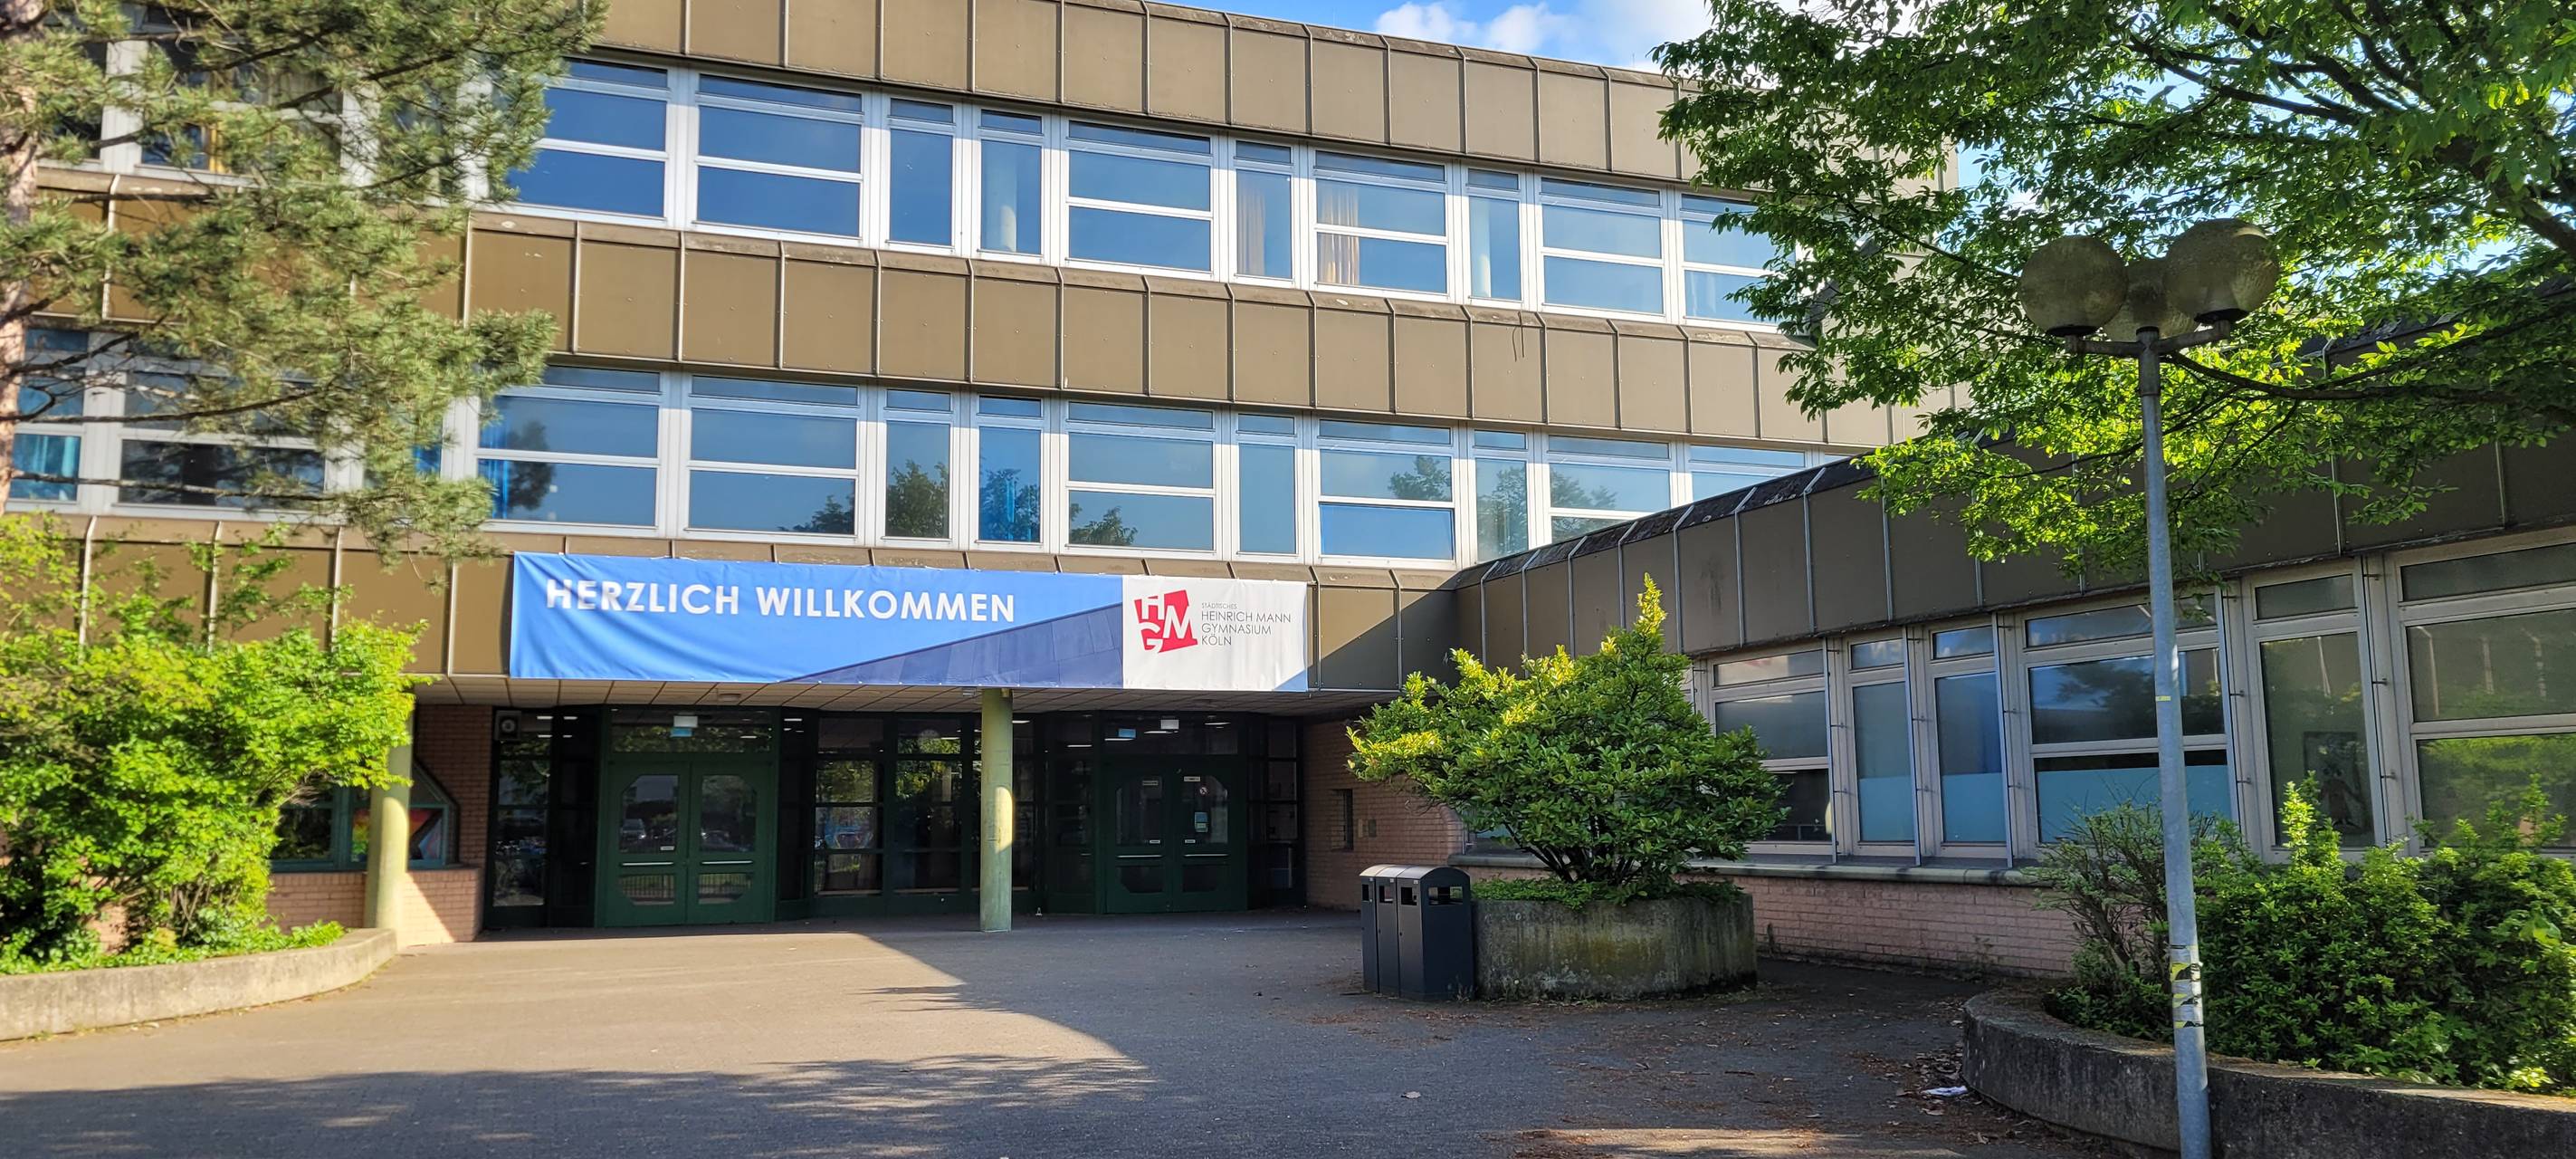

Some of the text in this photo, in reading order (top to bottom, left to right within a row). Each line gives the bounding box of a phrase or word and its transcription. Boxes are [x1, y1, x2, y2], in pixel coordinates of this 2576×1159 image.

[546, 579, 1014, 623] HERZLICH WILLKOMMEN
[1201, 610, 1292, 623] HEINRICH MANN
[1201, 623, 1272, 635] GYMNASIUM
[1201, 634, 1232, 646] KÖLN
